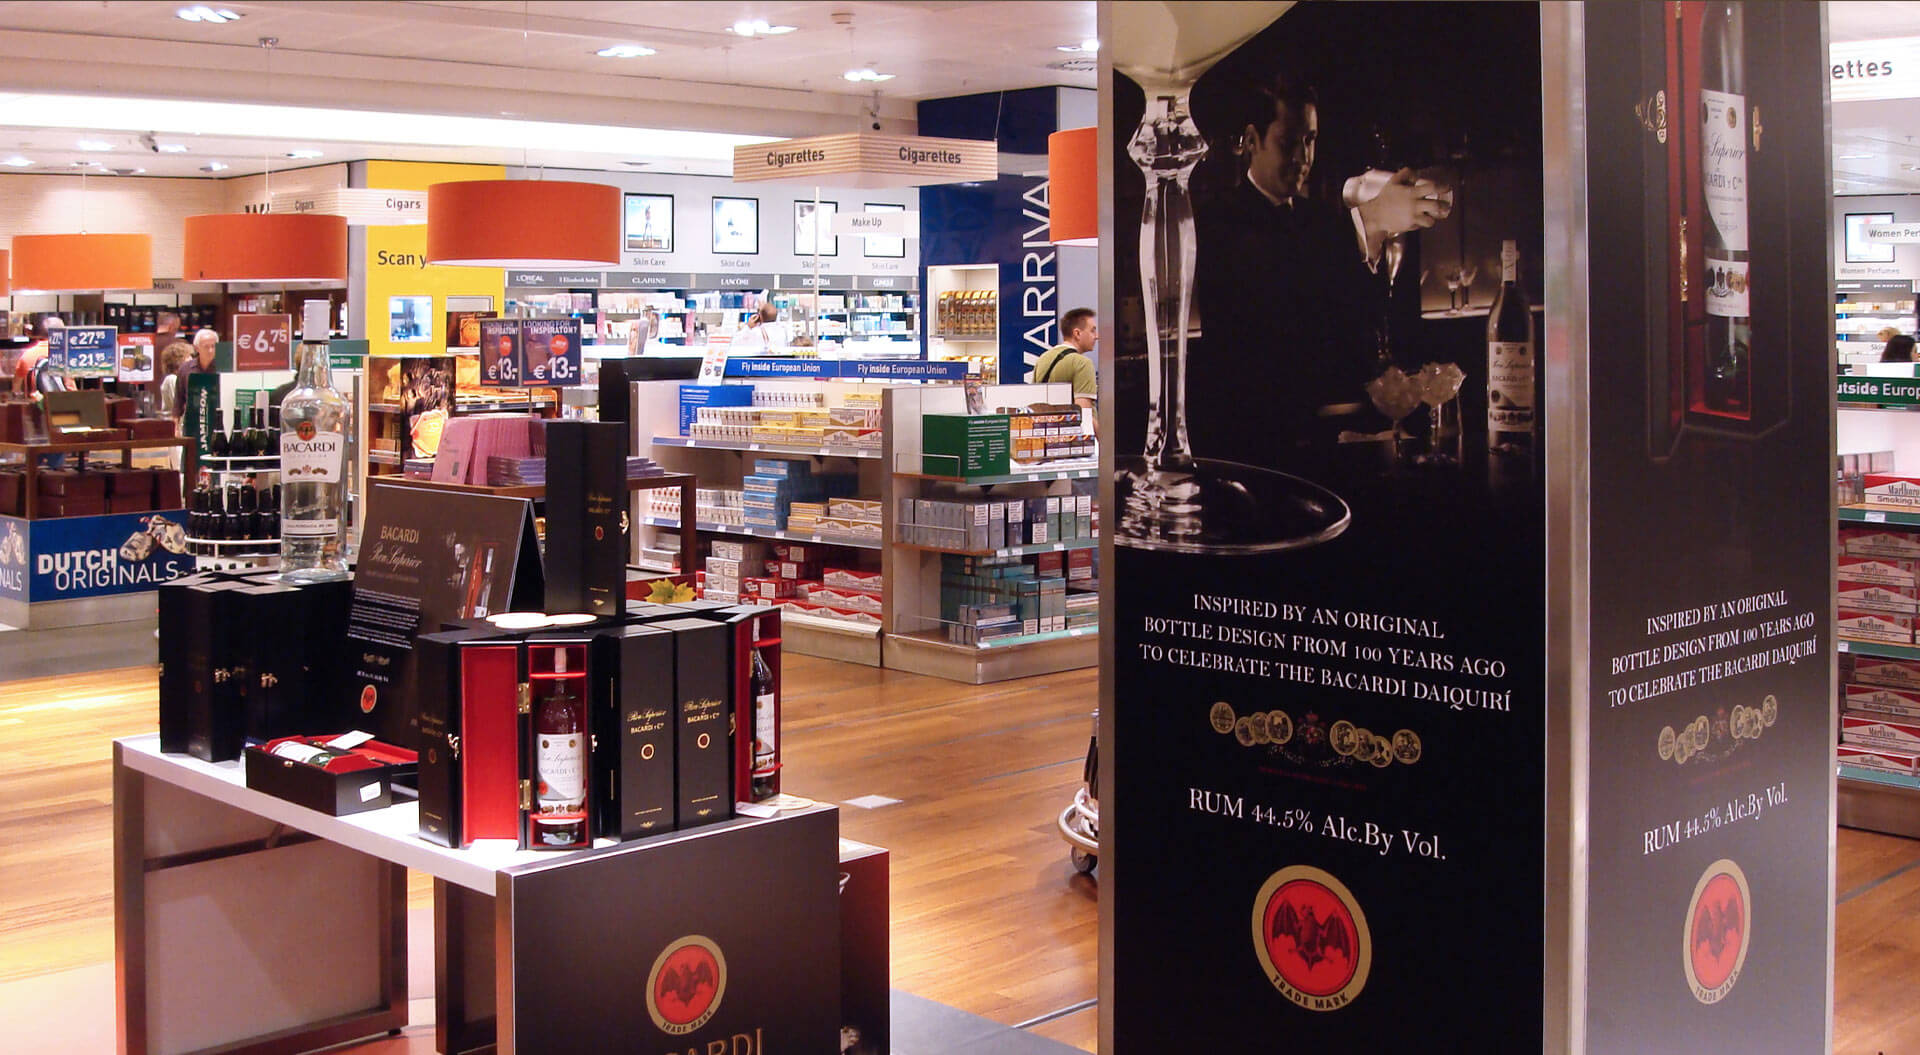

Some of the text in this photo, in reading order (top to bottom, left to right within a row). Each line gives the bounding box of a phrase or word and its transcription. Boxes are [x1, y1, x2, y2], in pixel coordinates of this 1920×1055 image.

[1832, 57, 1893, 79] ettes
[767, 148, 825, 166] Cigarettes
[899, 147, 962, 165] Cigarettes
[295, 200, 315, 212] Cigars
[386, 198, 421, 210] Cigars
[852, 217, 882, 229] Make Up
[1868, 229, 1902, 238] Women
[378, 250, 415, 265] Scan
[633, 257, 666, 266] Skin Care
[736, 260, 750, 268] Care
[742, 362, 821, 374] Fly inside European Union
[858, 364, 947, 376] Fly inside European Union
[1837, 382, 1878, 395] utside
[200, 389, 209, 451] JAMESON
[283, 442, 336, 453] BACARDI
[1877, 496, 1913, 505] Smoking
[381, 525, 420, 544] BACARDI
[38, 548, 118, 575] DUTCH
[0, 568, 22, 591] NALS
[55, 561, 179, 591] ORIGINALS
[1193, 593, 1445, 640] INSPIRED BY AN ORIGINAL
[1647, 590, 1788, 635] INSPIRED BY AN ORIGINAL
[1145, 616, 1506, 679] BOTTLE DESIGN FROM 100 YEARS AGO
[1612, 611, 1815, 676] BOTTLE DESIGN FROM 100 YEARS AGO
[1139, 643, 1512, 712] TO CELEBRATE THE BACARDI DAIQUIRÍ
[1608, 634, 1817, 708] TO CELEBRATE THE BACARDI DAIQUIRÍ
[1189, 788, 1447, 861] RUM 44.5% Alc.By Vol.
[1643, 782, 1788, 856] RUM 44.5% Alc.By Vol.
[1273, 974, 1349, 1010] TRADE MARK
[1694, 969, 1741, 1004] TRADE MARK
[662, 1010, 713, 1034] TRADE MARK
